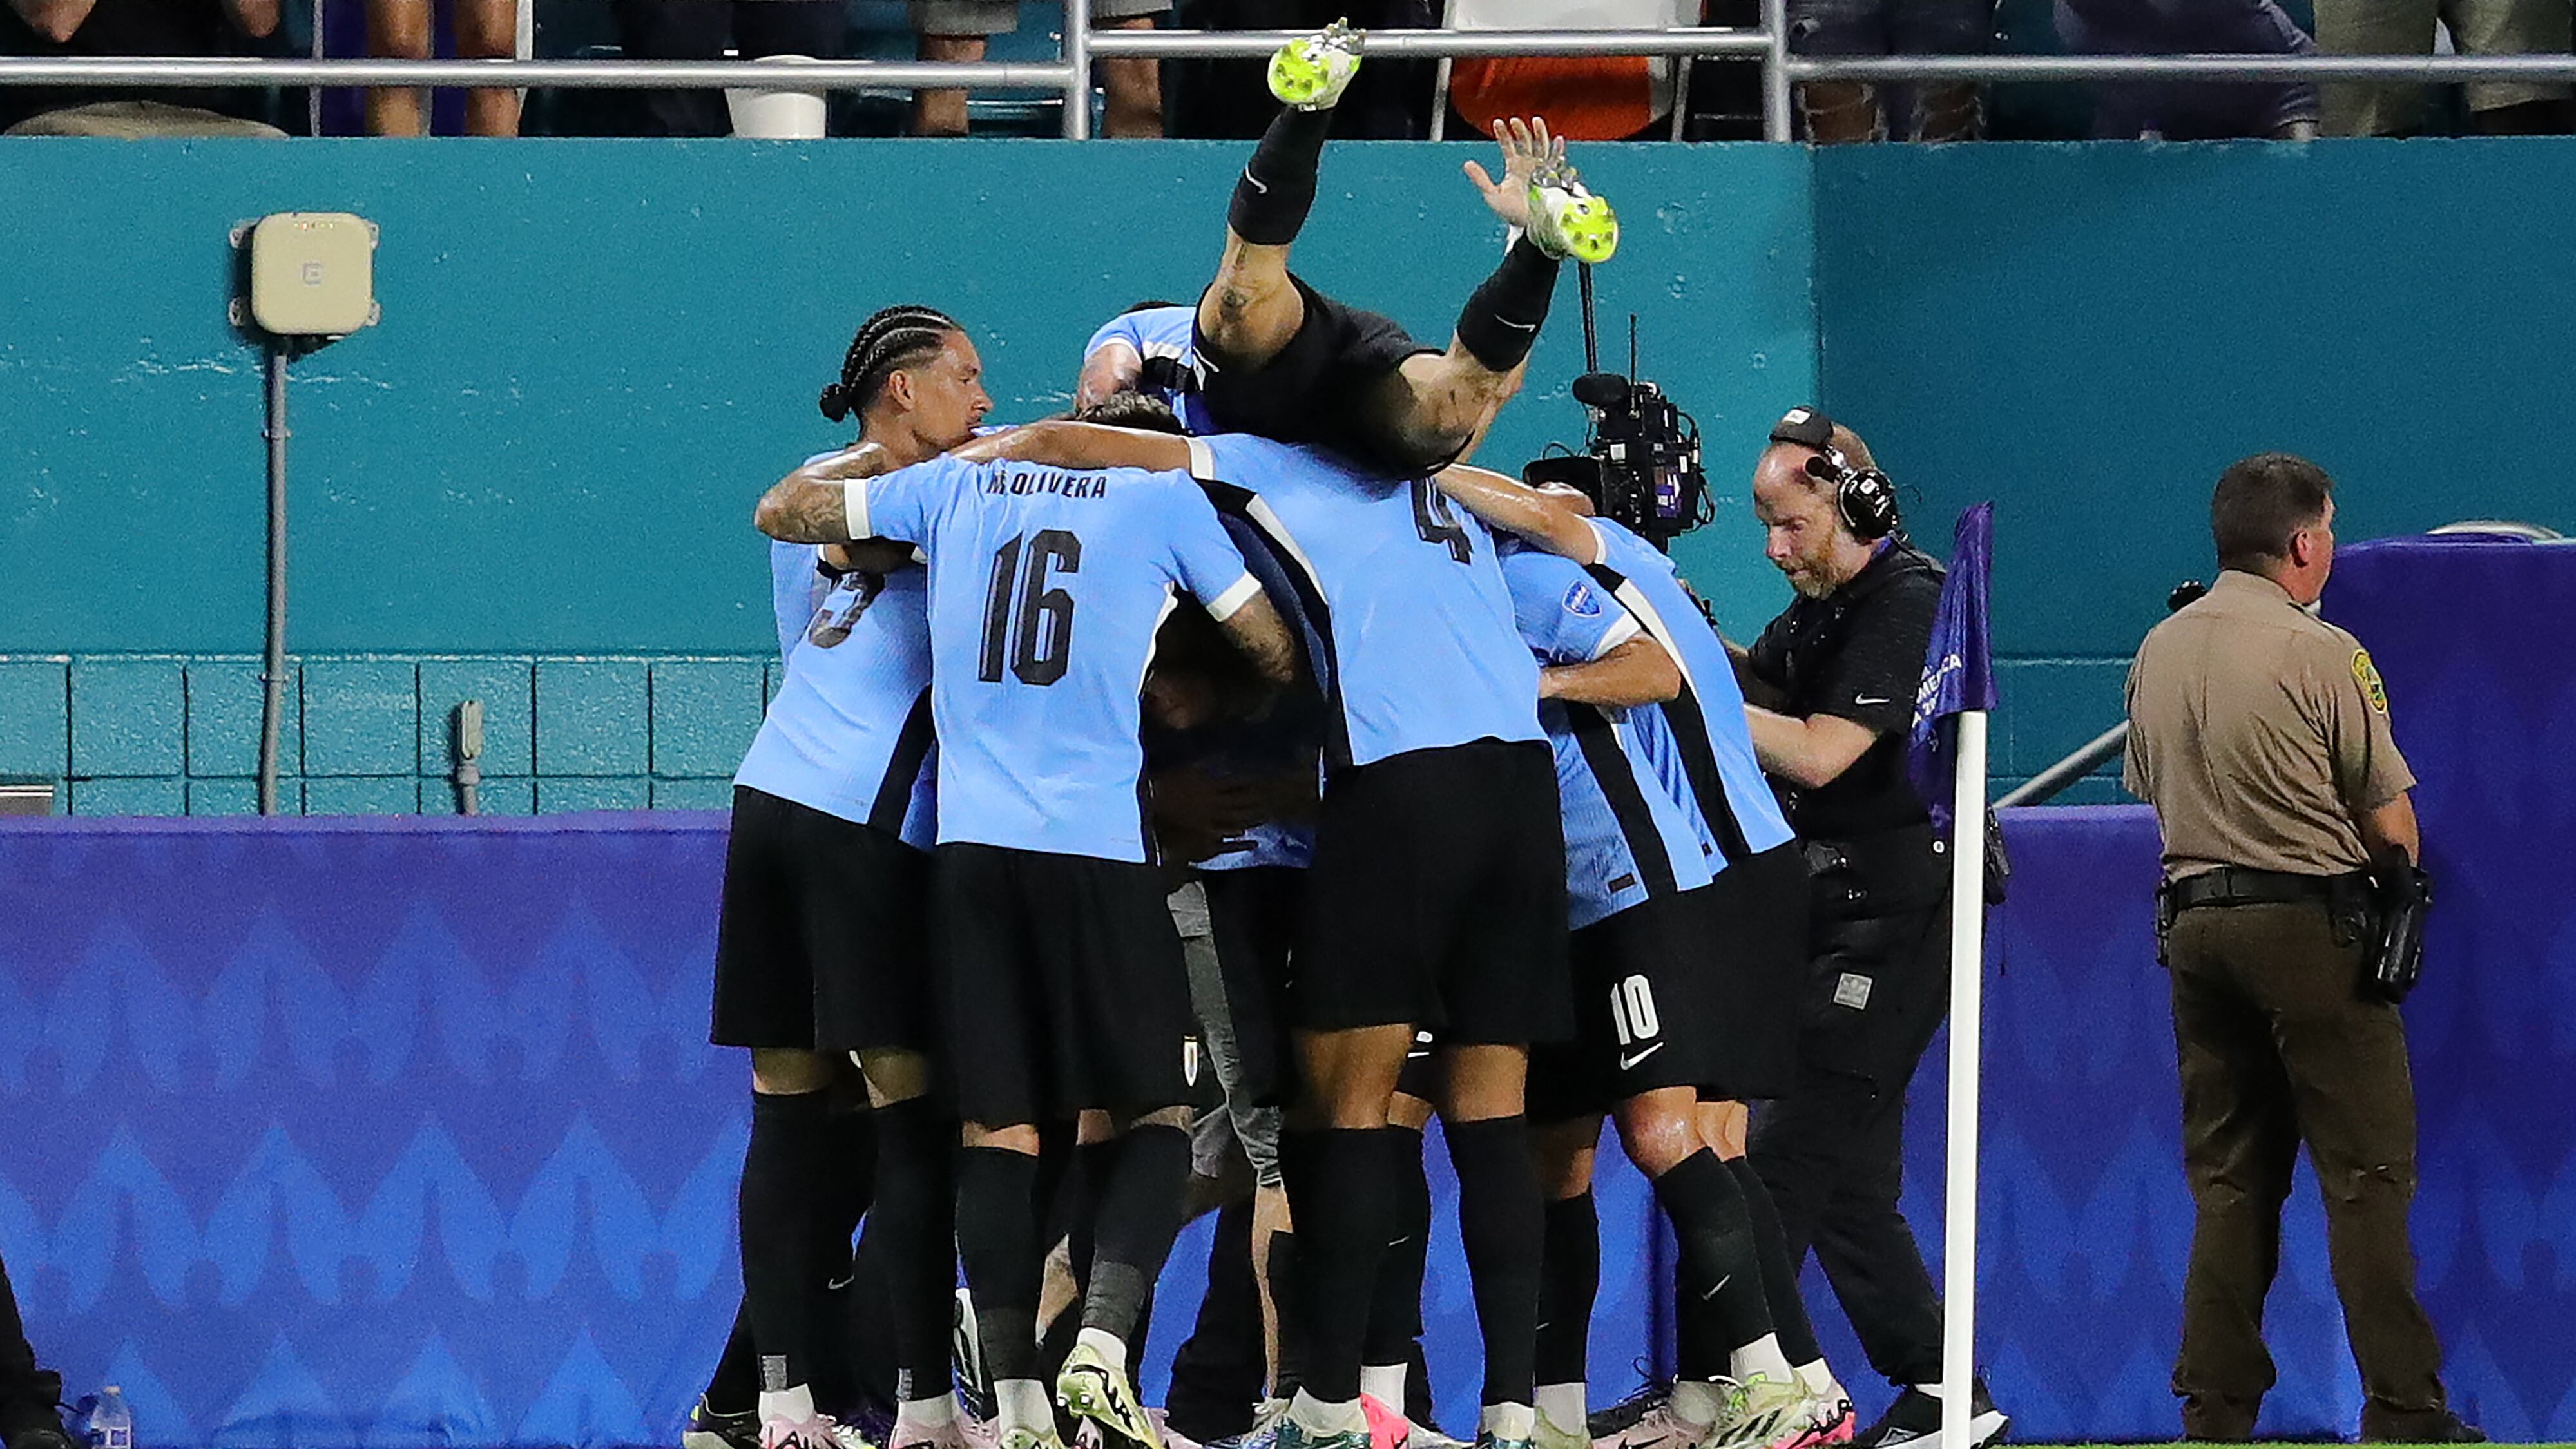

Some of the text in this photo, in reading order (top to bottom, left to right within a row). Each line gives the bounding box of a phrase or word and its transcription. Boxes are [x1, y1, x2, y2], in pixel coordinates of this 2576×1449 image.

[1411, 477, 1472, 565] 4
[979, 529, 1082, 686] 16
[1610, 974, 1660, 1045] 10
